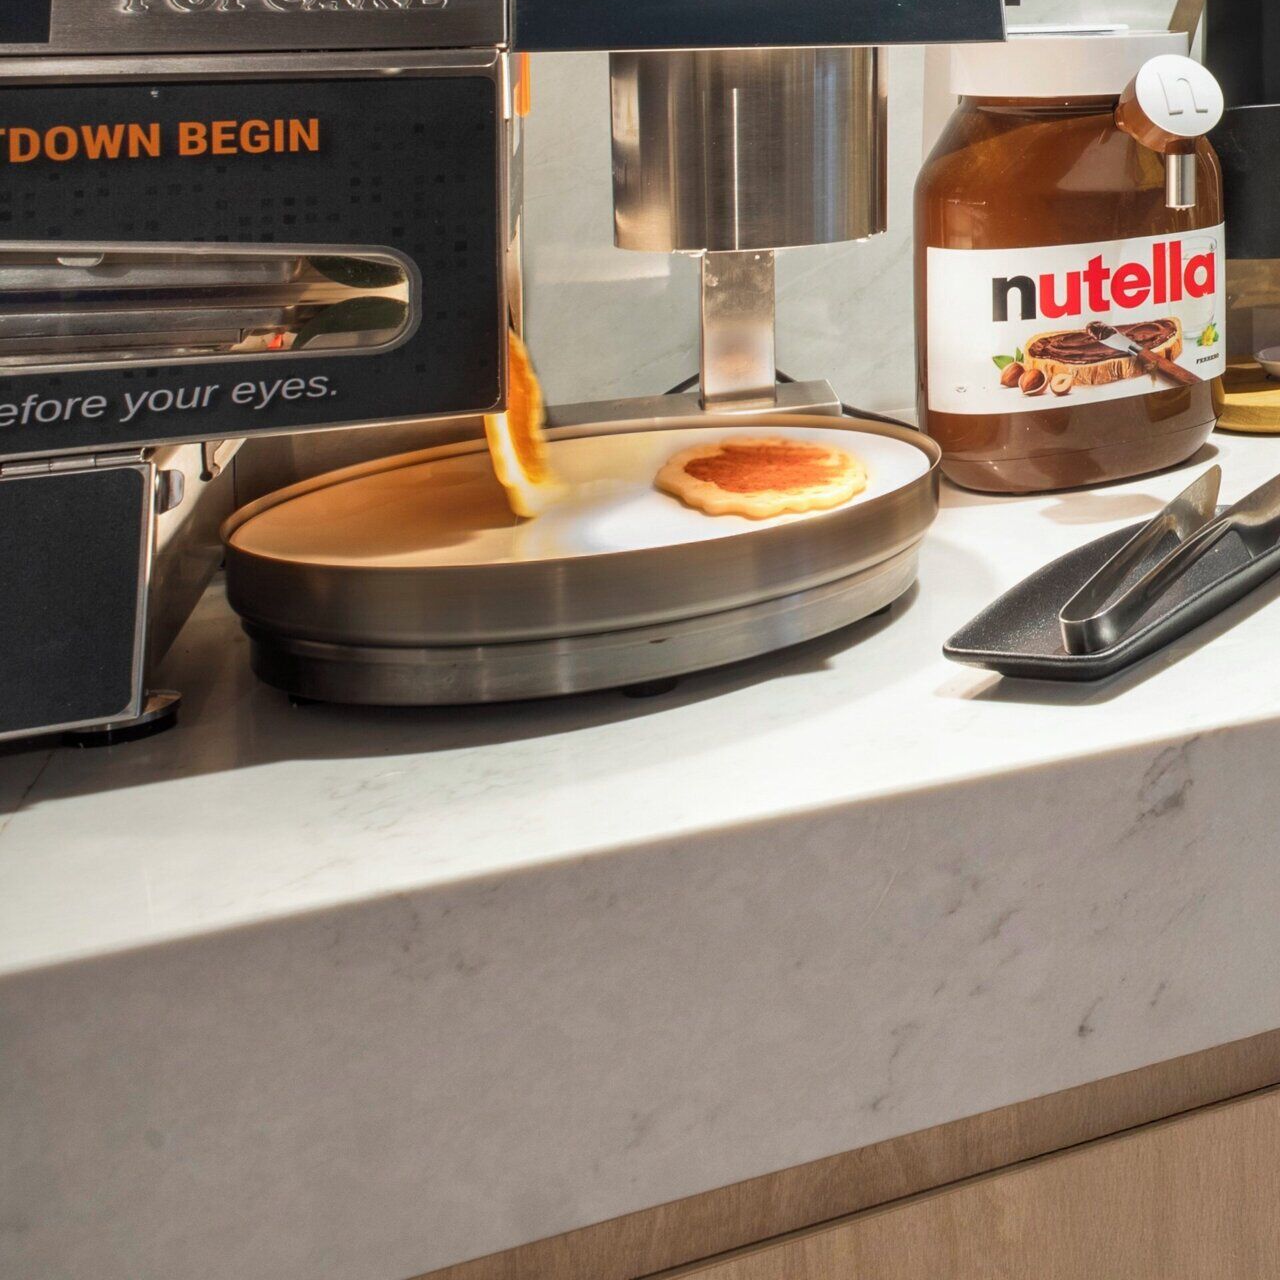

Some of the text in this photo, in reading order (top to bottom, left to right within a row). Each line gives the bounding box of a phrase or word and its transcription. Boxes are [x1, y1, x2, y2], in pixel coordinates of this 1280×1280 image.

[0, 118, 320, 163] DOWN BEGIN
[992, 240, 1216, 322] nutella
[119, 383, 220, 422] your
[230, 375, 338, 409] eyes.
